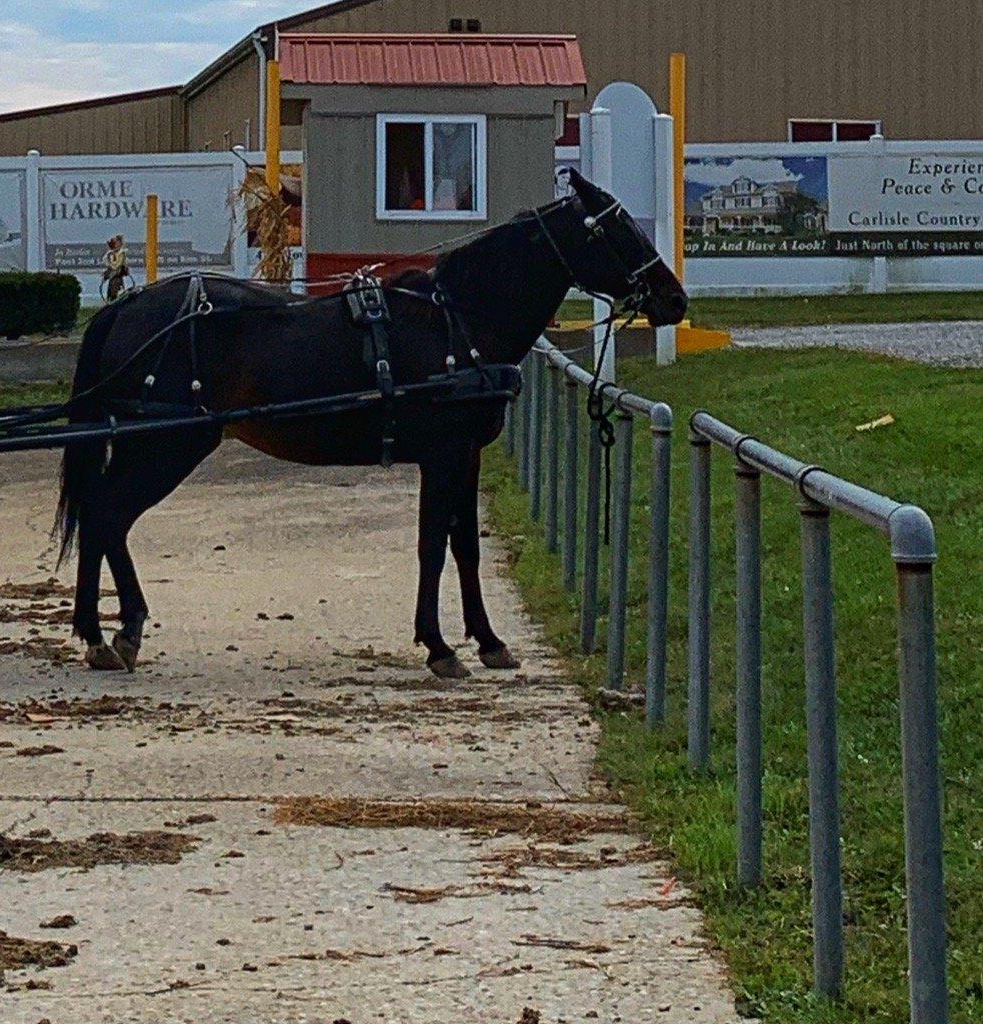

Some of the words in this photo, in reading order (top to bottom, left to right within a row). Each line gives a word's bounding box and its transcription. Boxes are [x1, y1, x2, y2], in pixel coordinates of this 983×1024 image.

[60, 180, 133, 199] ORME
[882, 178, 932, 195] Peace
[941, 178, 956, 195] &
[50, 199, 193, 219] HARDWRE
[848, 211, 909, 226] Carlisle
[917, 211, 979, 227] Country
[703, 241, 717, 251] In
[719, 240, 743, 251] And
[746, 240, 776, 252] Have
[779, 240, 788, 251] A
[791, 240, 826, 251] Look!
[836, 239, 858, 250] Just
[862, 239, 894, 250] North
[897, 238, 908, 250] of
[912, 239, 929, 250] the
[933, 240, 970, 252] square
